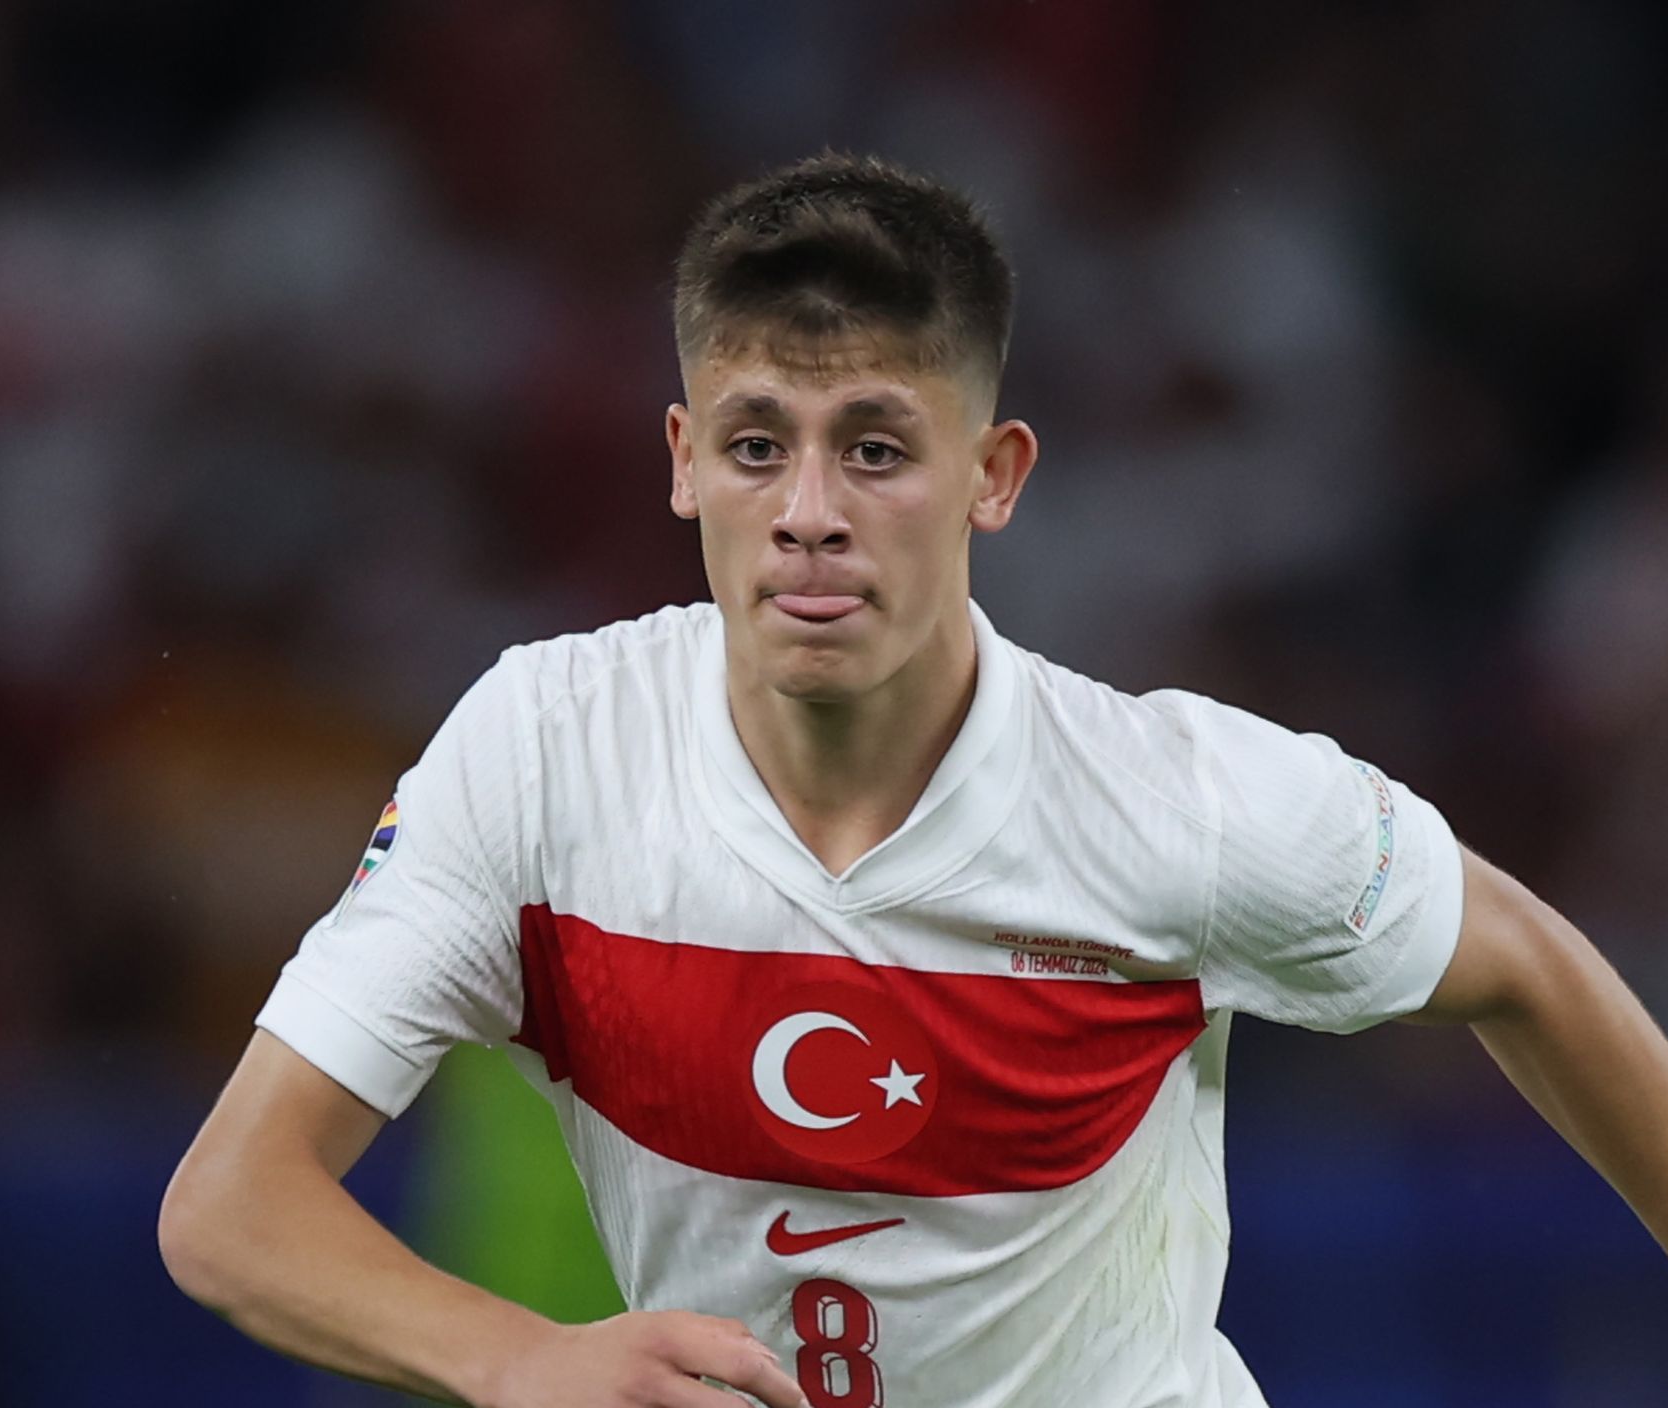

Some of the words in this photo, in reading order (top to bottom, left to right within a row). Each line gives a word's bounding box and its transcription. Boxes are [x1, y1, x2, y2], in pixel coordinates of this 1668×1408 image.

[1011, 951, 1025, 973] 06
[1028, 951, 1078, 974] TEMMUZ
[1080, 956, 1108, 976] 2024
